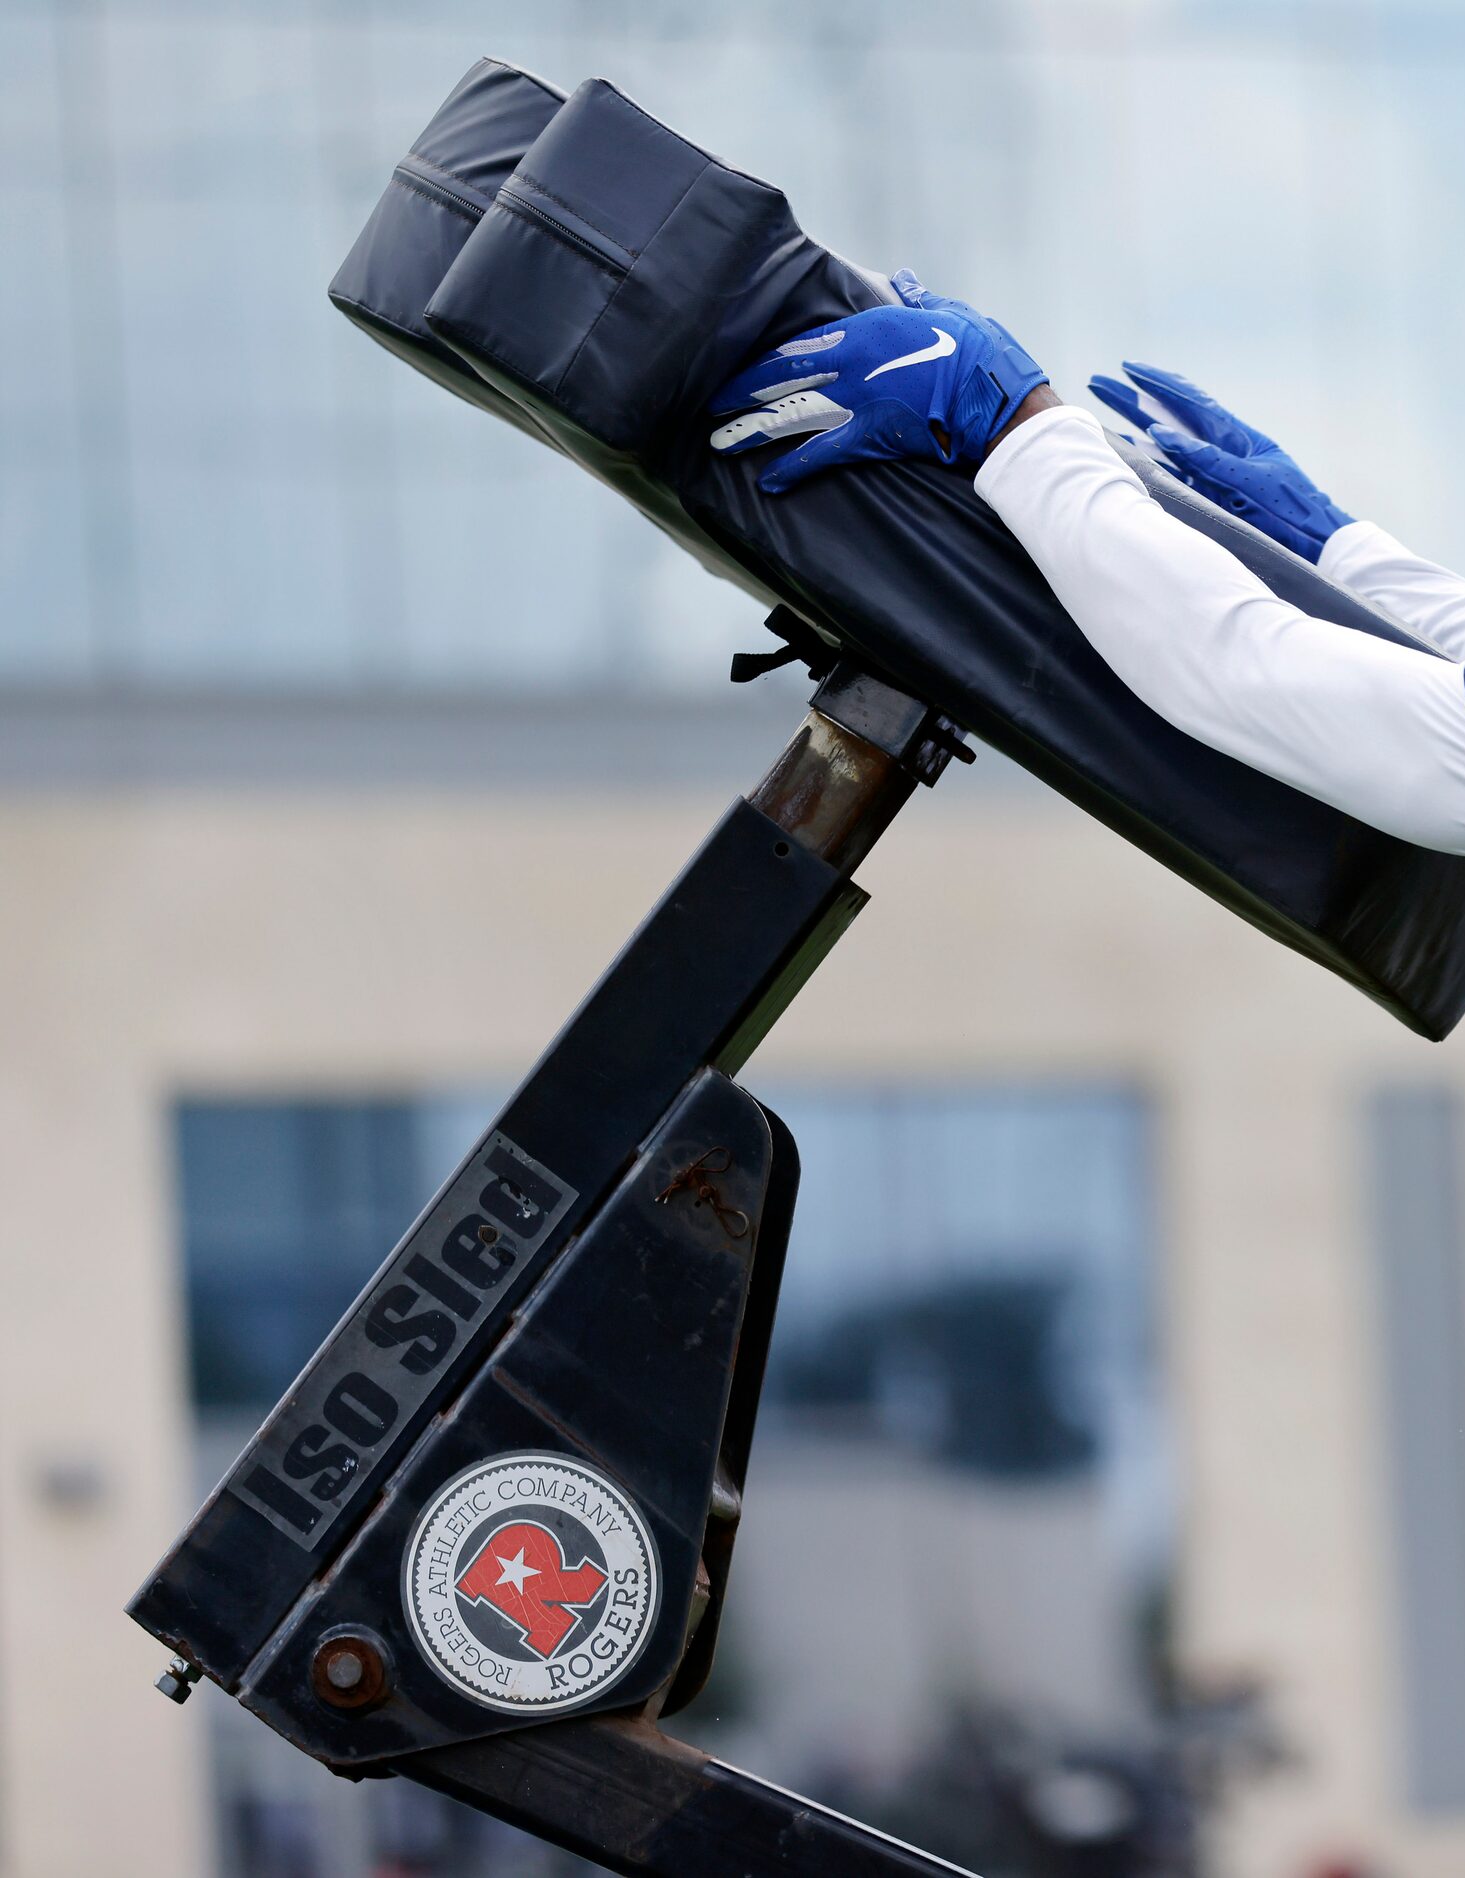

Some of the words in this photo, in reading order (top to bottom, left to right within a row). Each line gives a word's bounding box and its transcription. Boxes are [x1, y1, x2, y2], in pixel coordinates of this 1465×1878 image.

[247, 1373, 399, 1536] Iso
[364, 1145, 563, 1377] Sled
[428, 1490, 492, 1599] ATHLETIC
[497, 1477, 623, 1537] COMPANY
[433, 1607, 512, 1686] ROGERS
[545, 1567, 639, 1690] ROGERS
